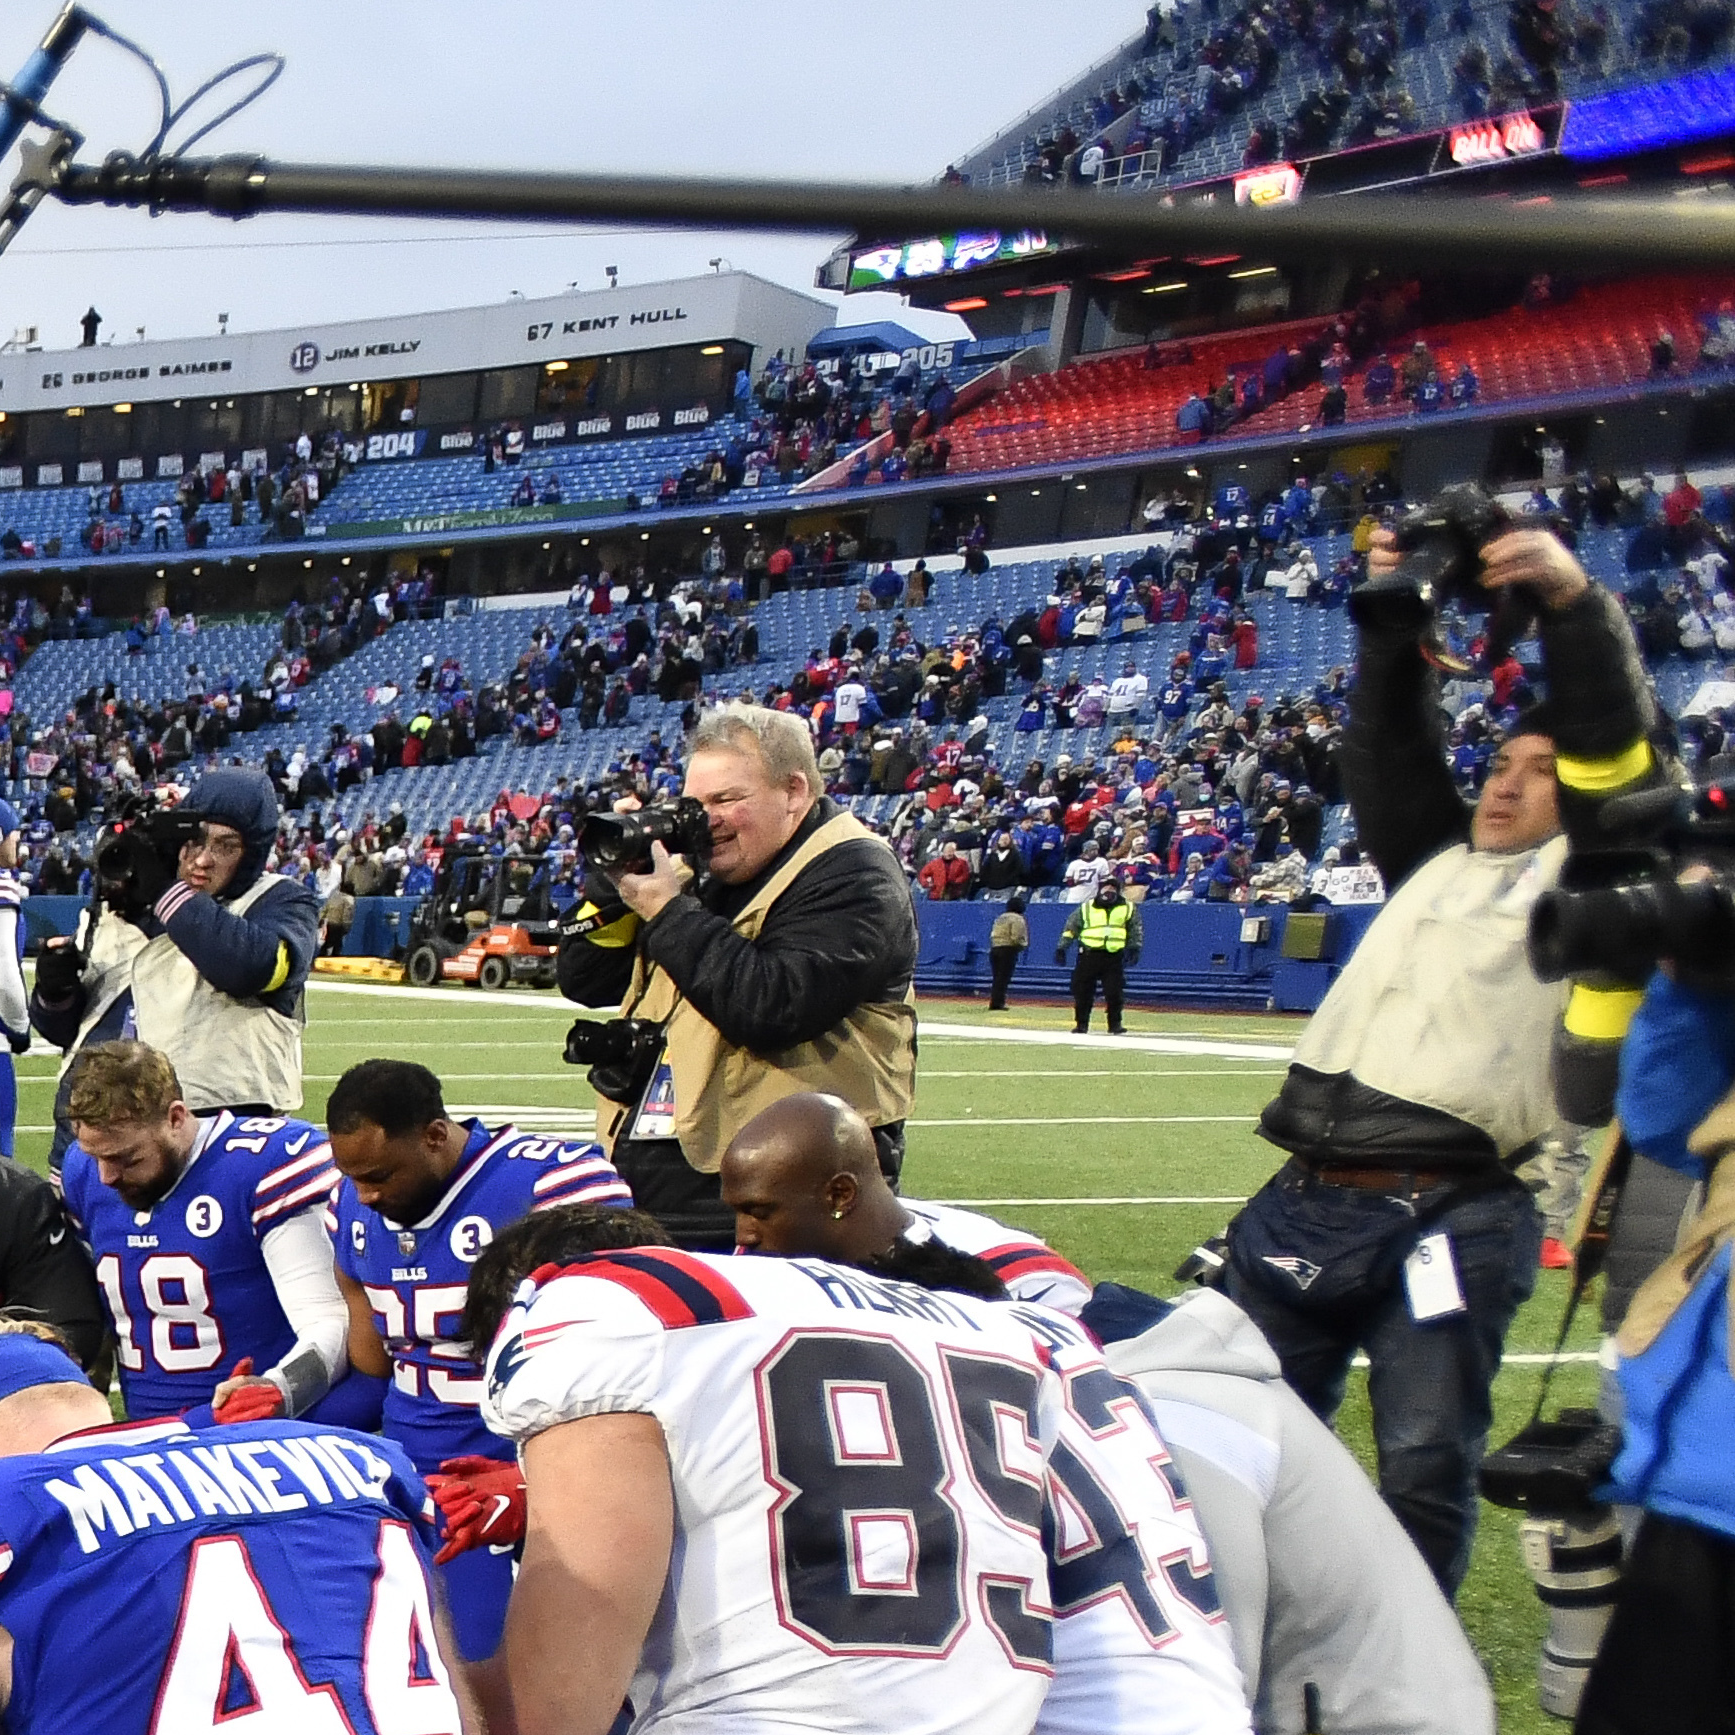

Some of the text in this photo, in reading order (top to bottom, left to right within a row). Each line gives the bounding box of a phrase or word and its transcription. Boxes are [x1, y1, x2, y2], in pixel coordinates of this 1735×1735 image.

[1451, 112, 1545, 164] BALL ON
[527, 308, 688, 342] 67 KENT HULL
[294, 340, 421, 368] 12 JIM KELLY
[577, 418, 612, 437] Blue
[626, 411, 661, 431] Blue
[674, 406, 709, 425] Blue
[366, 431, 417, 461] 204
[441, 432, 474, 450] Blue
[533, 422, 567, 441] Blue
[1164, 690, 1181, 705] 97
[196, 1202, 211, 1231] 3
[462, 1221, 481, 1257] 3
[391, 1267, 429, 1282] BILLS
[96, 1253, 225, 1374] 18
[363, 1284, 486, 1407] 25
[753, 1326, 1057, 1679] 85
[1044, 1360, 1228, 1651] 43
